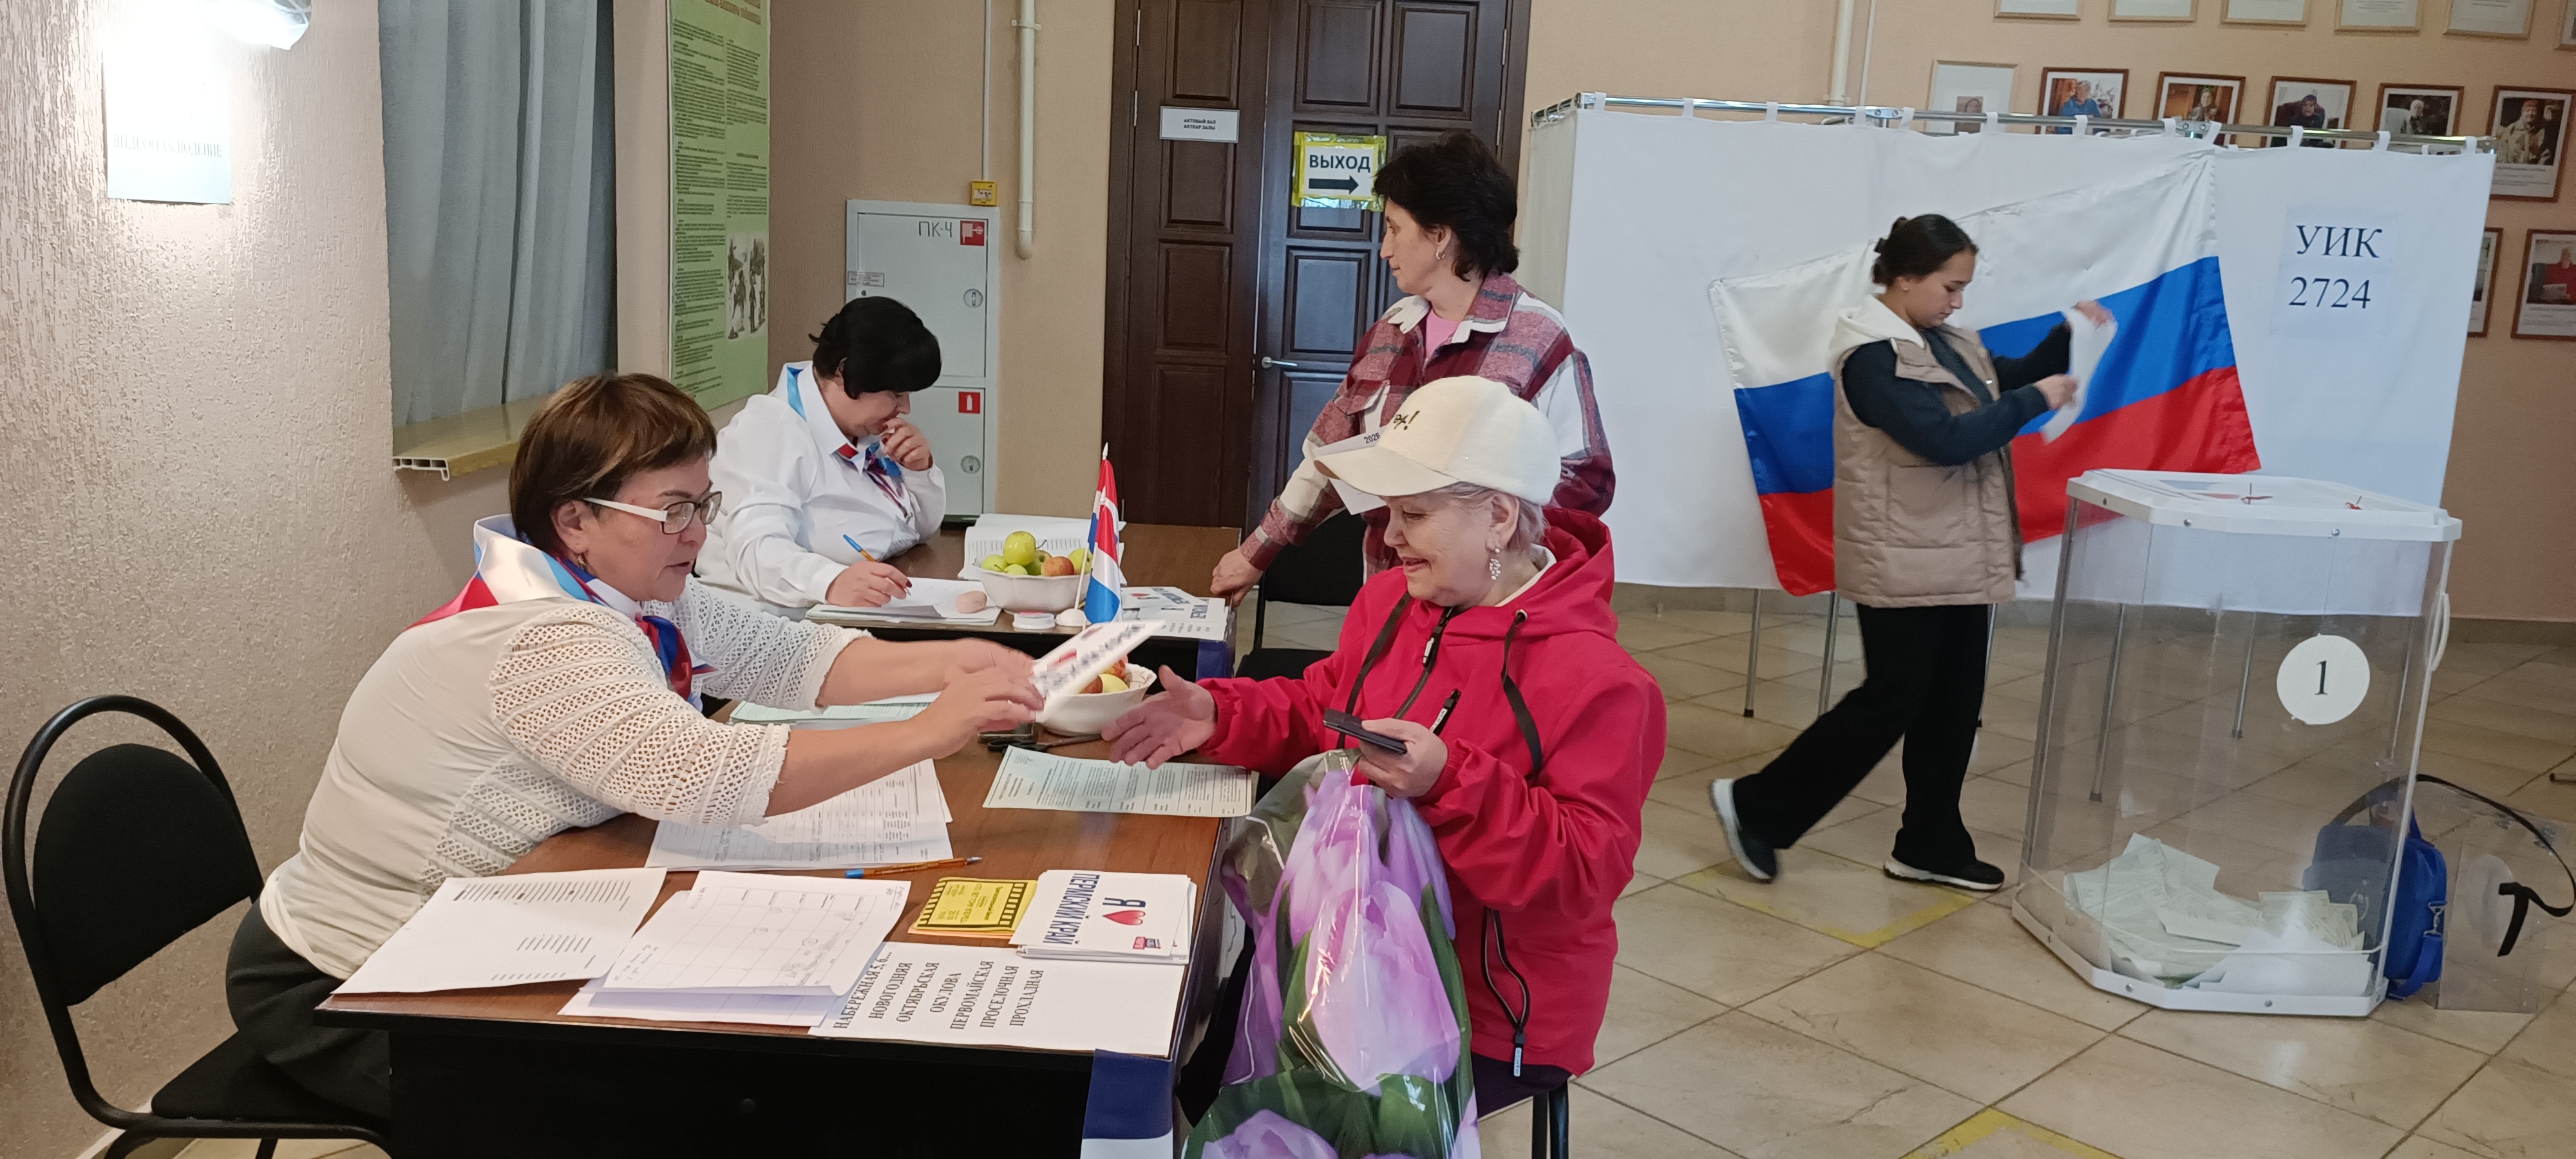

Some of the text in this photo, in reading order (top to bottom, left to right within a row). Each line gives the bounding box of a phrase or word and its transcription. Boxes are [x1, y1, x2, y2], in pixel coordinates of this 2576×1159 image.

[1309, 155, 1370, 173] ВЫХОД
[2295, 225, 2383, 258] УИК
[2288, 276, 2371, 309] 2724
[2315, 659, 2329, 695] 1
[1043, 873, 1101, 945] ПЕРМСКИЙ КРАЙ
[1103, 897, 1146, 908] Я
[833, 970, 881, 1029] НАБЕРЕЖНАЯ
[868, 963, 913, 1019] НОВОГОДНЯЯ
[896, 963, 940, 1022] ОКТЯБРЬСКАЯ
[929, 972, 961, 1013] ОКУЛОВА
[949, 961, 994, 1030] ПЕРВОМАЙСКАЯ
[980, 965, 1019, 1028] ПРОСЕЛОЧНАЯ
[1009, 970, 1045, 1026] ПРОХЛАДНАЯ
